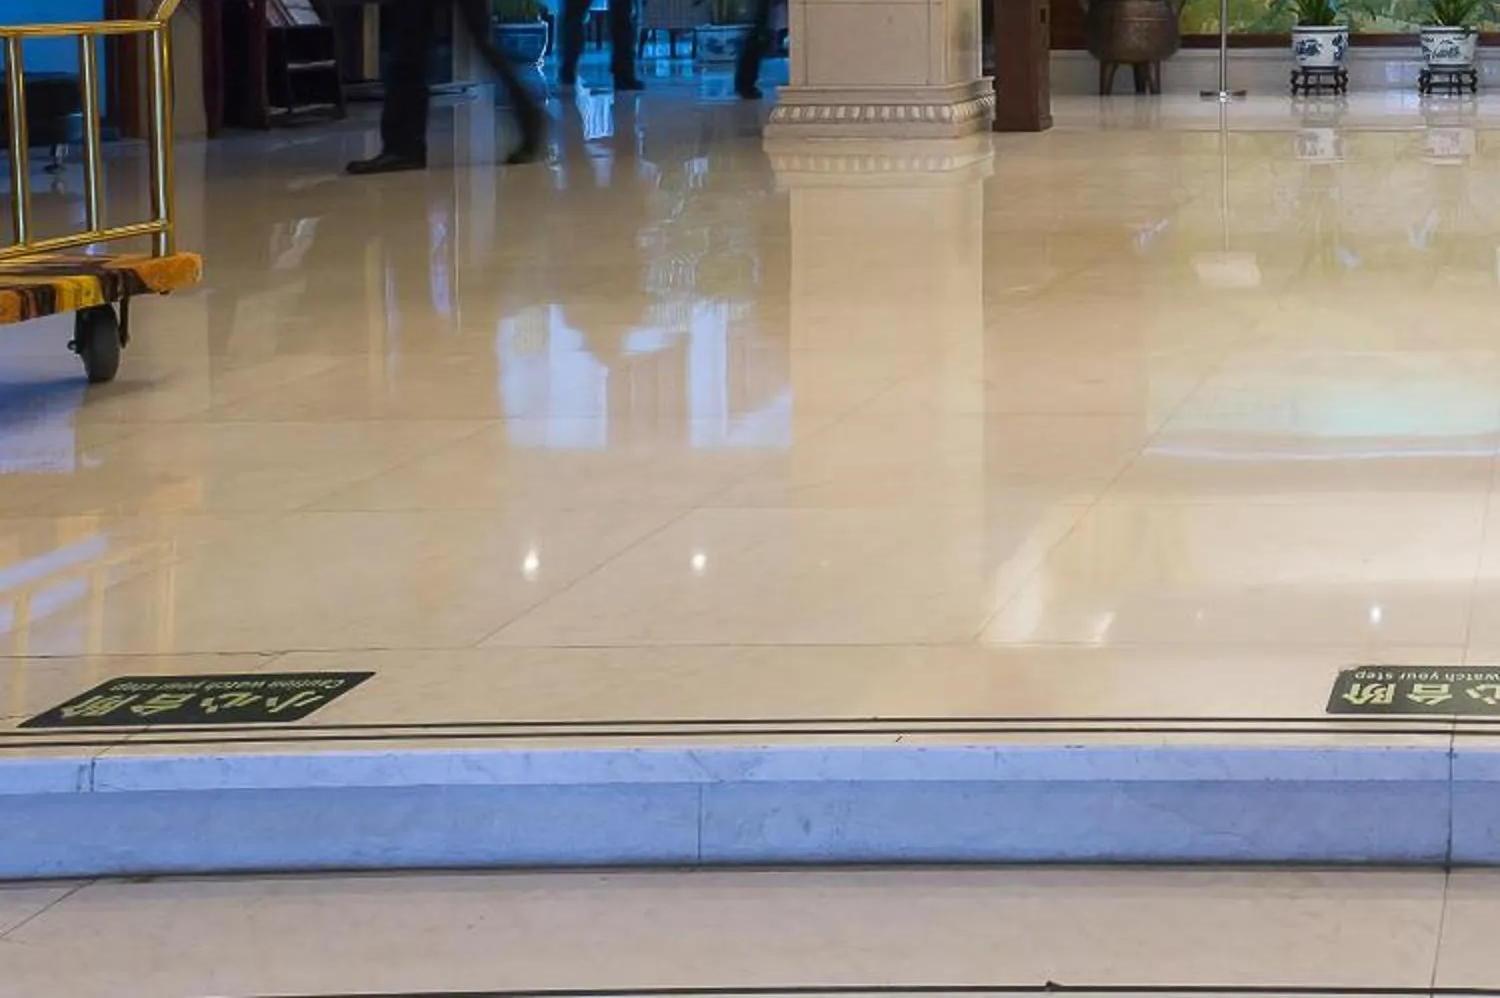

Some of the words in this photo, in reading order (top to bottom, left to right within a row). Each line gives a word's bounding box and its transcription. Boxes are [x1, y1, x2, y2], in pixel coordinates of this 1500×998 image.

[1354, 670, 1393, 681] step
[1398, 671, 1440, 682] your
[1444, 671, 1500, 683] watch
[60, 691, 326, 719] 小心台阶
